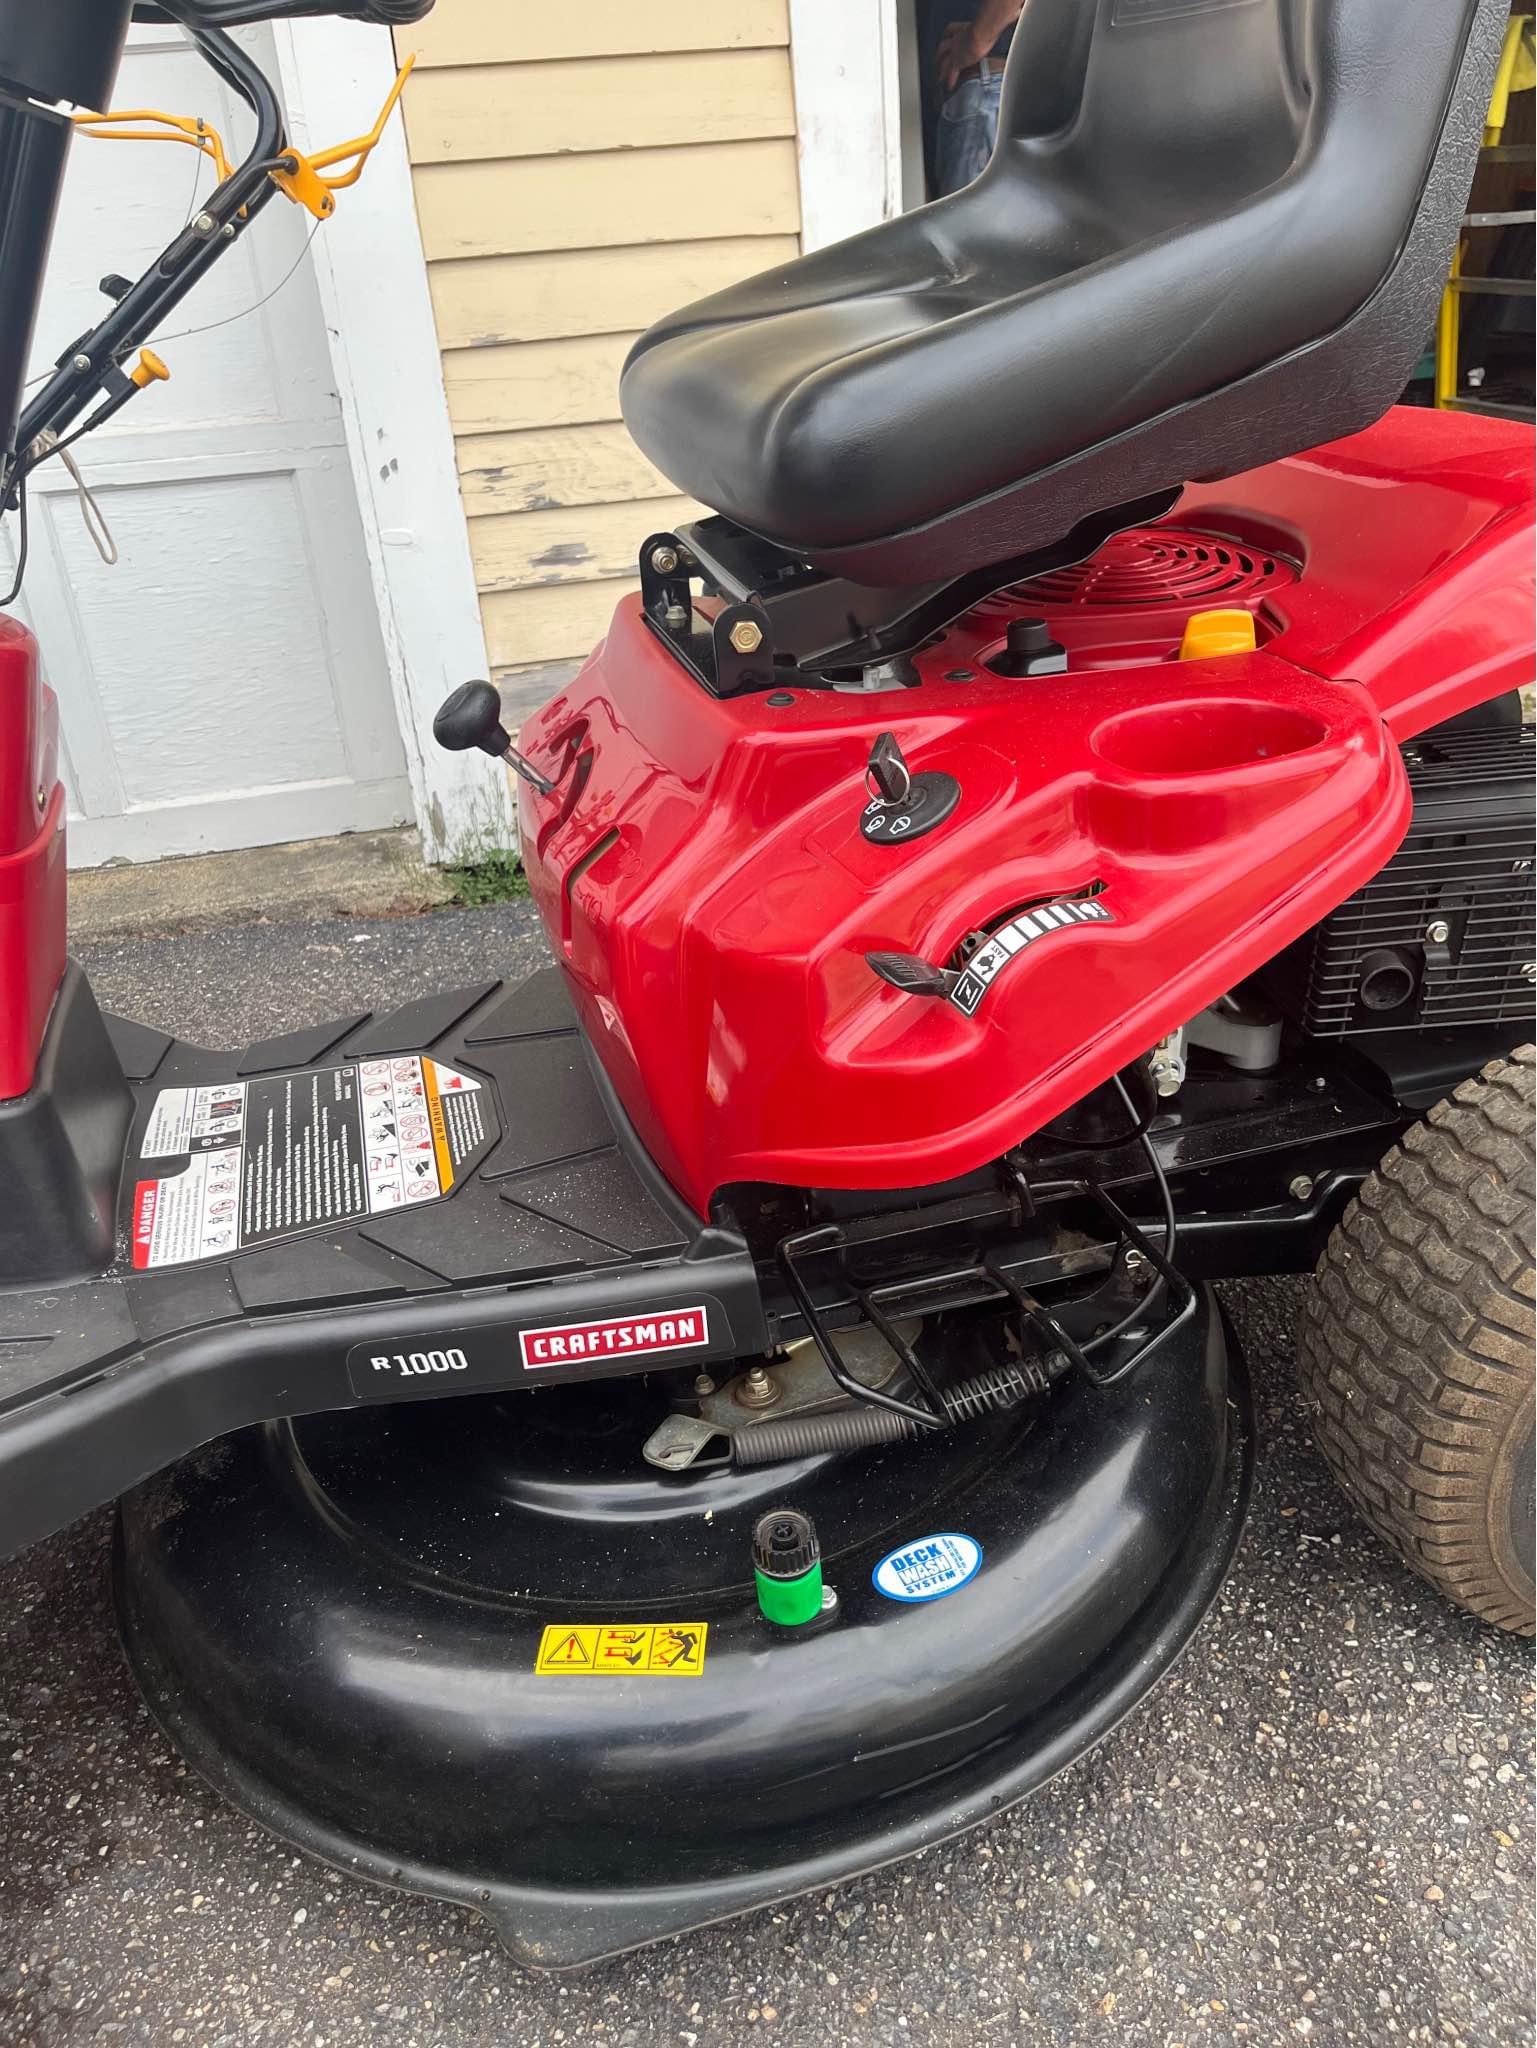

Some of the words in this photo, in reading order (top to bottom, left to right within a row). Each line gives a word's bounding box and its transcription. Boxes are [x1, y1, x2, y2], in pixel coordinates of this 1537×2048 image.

[431, 1096, 445, 1133] WARNING
[138, 1190, 155, 1233] DANGER
[533, 1317, 696, 1358] CRAFTSMAN
[890, 1543, 943, 1572] DECK
[897, 1555, 952, 1586] WASH
[905, 1570, 957, 1594] SYSTEM
